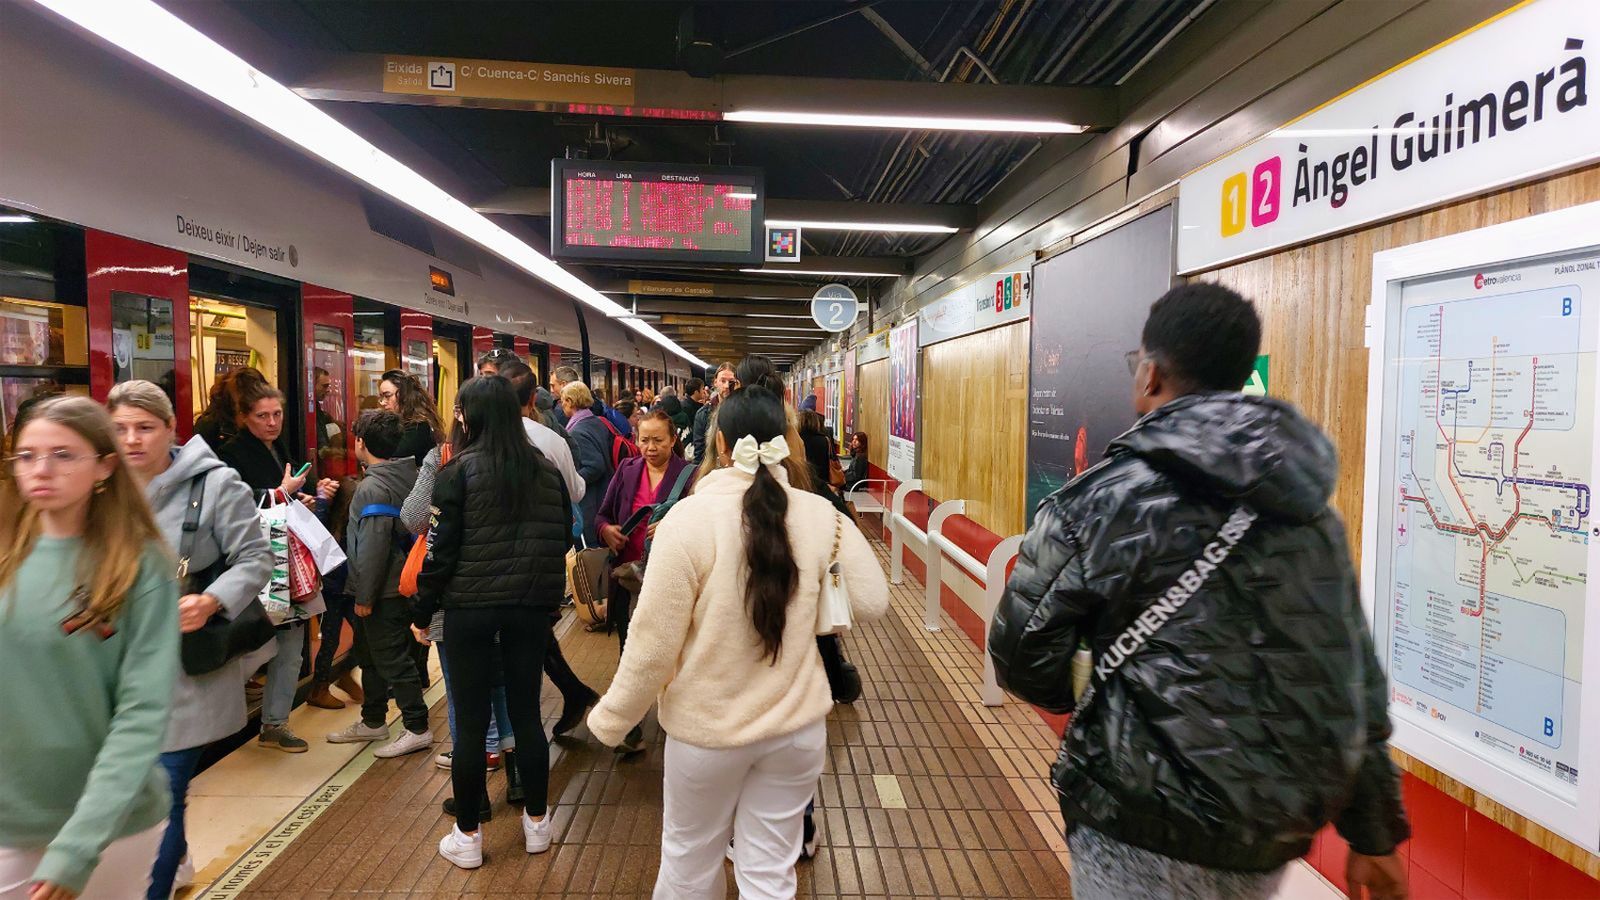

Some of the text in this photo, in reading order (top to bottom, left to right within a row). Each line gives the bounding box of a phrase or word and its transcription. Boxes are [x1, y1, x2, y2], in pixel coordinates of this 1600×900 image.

[386, 62, 423, 75] Eixida
[543, 69, 591, 85] Sanchís
[594, 72, 632, 86] Sivera
[1293, 125, 1378, 208] Àngel
[1390, 38, 1588, 171] Guimerà
[661, 174, 700, 182] DESTINACIÓ
[176, 214, 213, 242] Deixeu
[215, 228, 235, 249] eixir
[242, 235, 268, 259] Dejen
[269, 246, 285, 262] salir
[829, 302, 844, 325] 2
[1562, 297, 1573, 317] B
[1544, 716, 1554, 737] B
[316, 784, 344, 806] parat
[297, 804, 322, 822] està
[273, 820, 304, 838] tren
[256, 849, 273, 858] si
[266, 840, 284, 850] el
